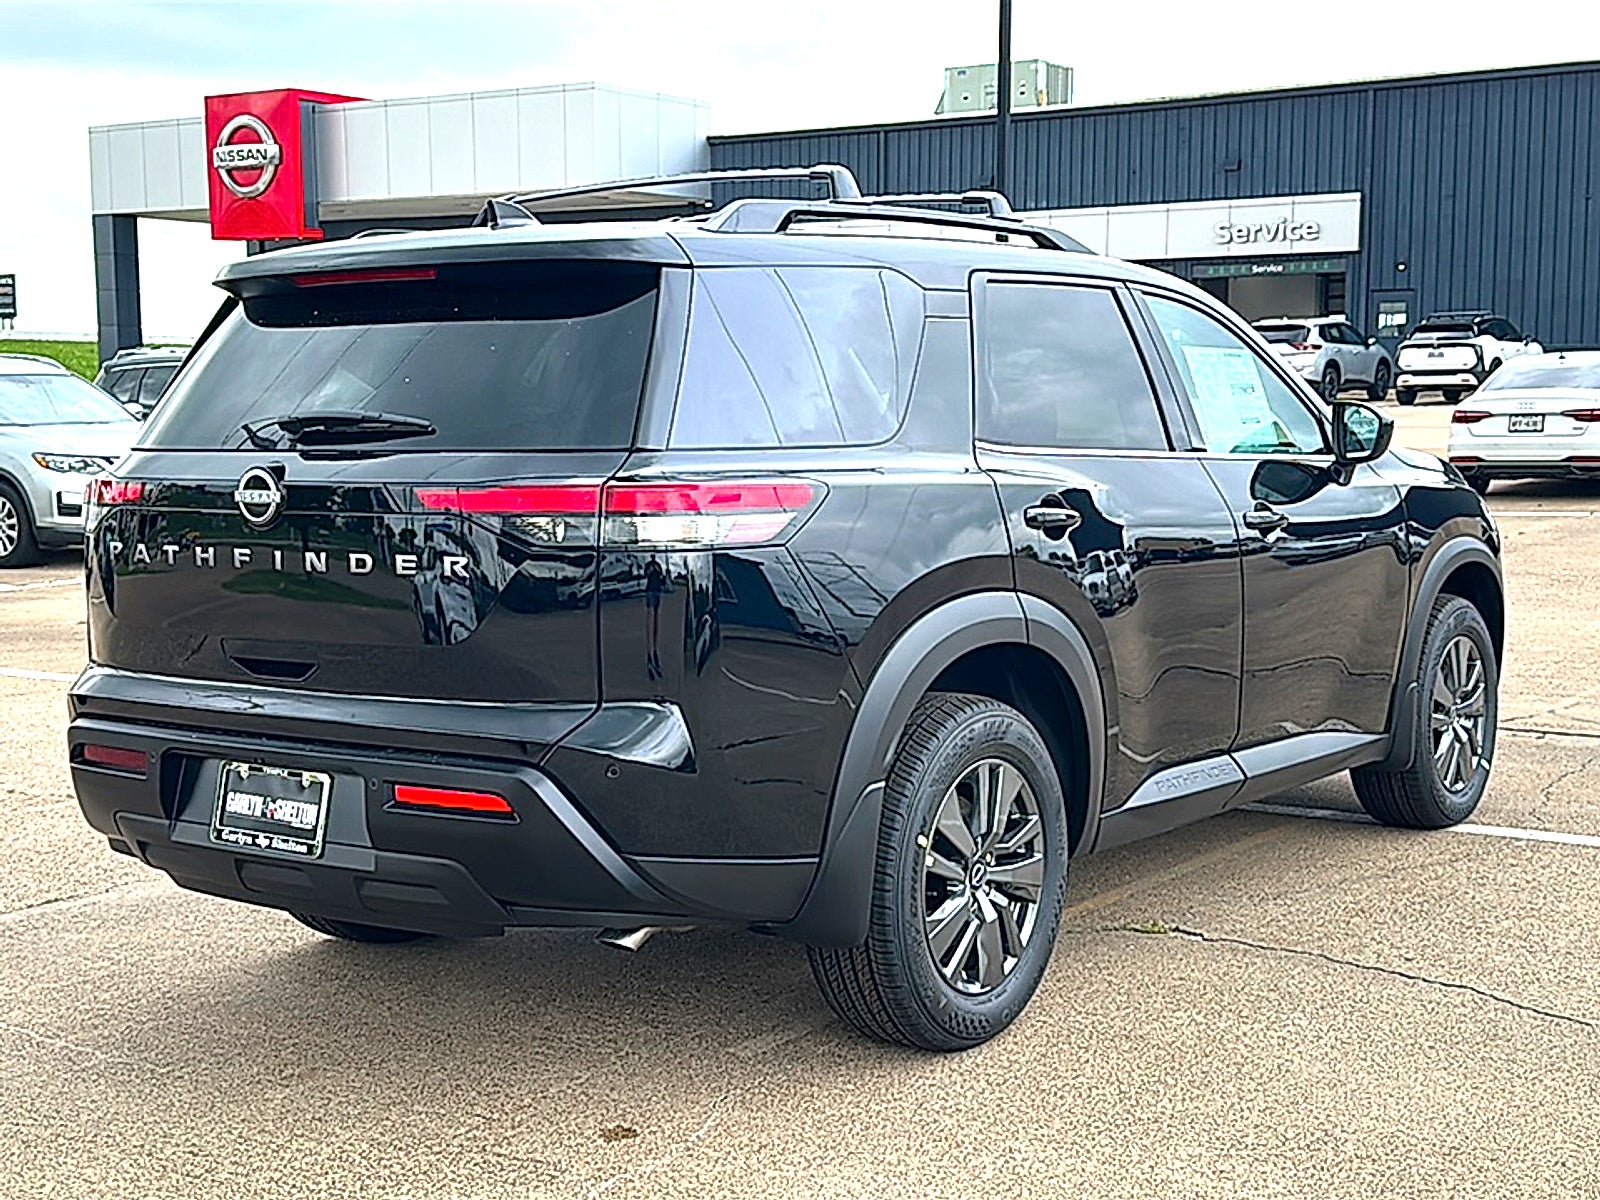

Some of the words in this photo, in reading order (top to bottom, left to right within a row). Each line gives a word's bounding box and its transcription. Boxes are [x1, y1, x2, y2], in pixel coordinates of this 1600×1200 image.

[215, 148, 268, 163] NISSAN
[1214, 217, 1320, 245] Service
[1251, 263, 1284, 275] Service
[236, 490, 280, 503] NISSAN
[109, 540, 471, 579] PATHFINDER
[1154, 762, 1238, 793] PATHFINDER
[273, 797, 319, 828] SHELTON
